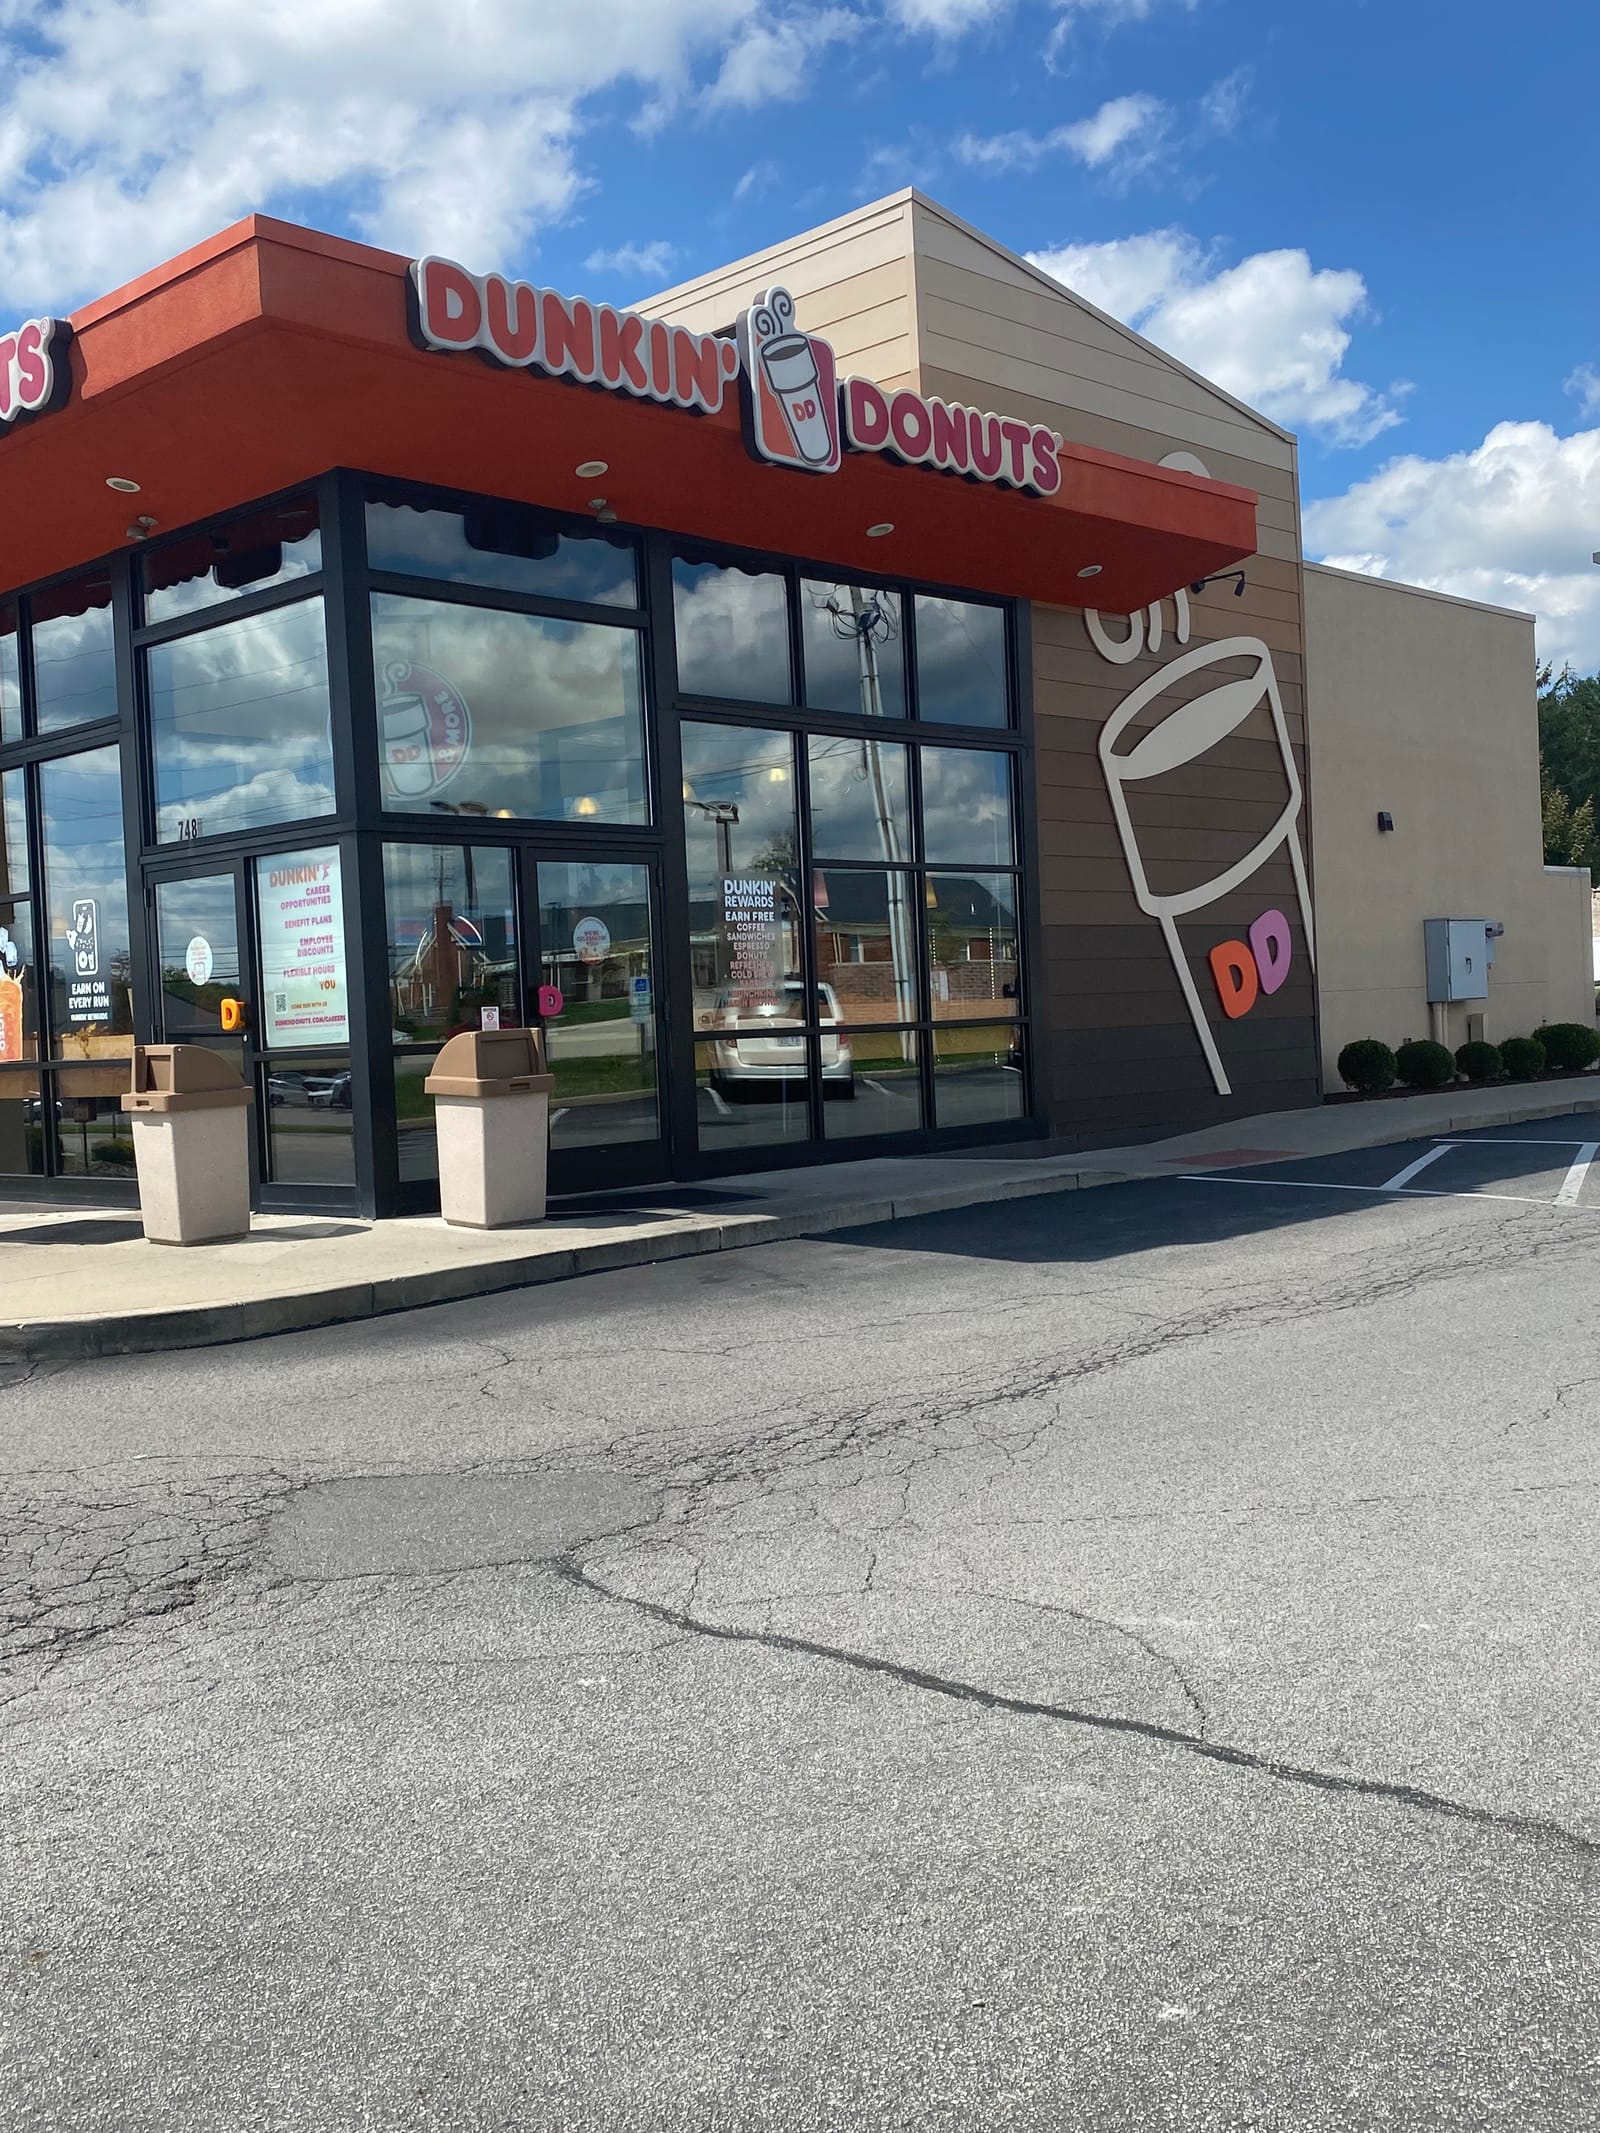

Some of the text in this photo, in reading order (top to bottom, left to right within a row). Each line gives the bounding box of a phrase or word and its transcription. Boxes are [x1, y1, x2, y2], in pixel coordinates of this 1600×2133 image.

[425, 261, 1059, 491] DUNKIN' DONUTS
[791, 398, 816, 422] DD
[178, 818, 197, 841] 748
[269, 866, 320, 888] DUNKIN'
[305, 885, 330, 896] CAREER
[723, 879, 776, 895] DUNKIN'
[280, 895, 331, 910] OPPORTUNITIES
[724, 896, 774, 908] REWARDS
[284, 915, 332, 929] BENEFIT PLANS
[725, 911, 775, 922] EARN FREE
[736, 923, 766, 931] COFFEE
[299, 934, 333, 946] EMPLOYEE
[726, 932, 776, 941] SANDWICHES
[296, 945, 334, 957] DISCOUNTS
[733, 942, 770, 950] ESPRESSO
[736, 951, 768, 960] DONUTS
[1209, 909, 1291, 1019] DD
[312, 965, 335, 976] HOURS
[731, 970, 752, 979] COLD
[71, 981, 105, 995] EARN ON
[319, 980, 336, 990] YOU
[68, 995, 110, 1009] EVERY RUN
[220, 998, 241, 1031] D
